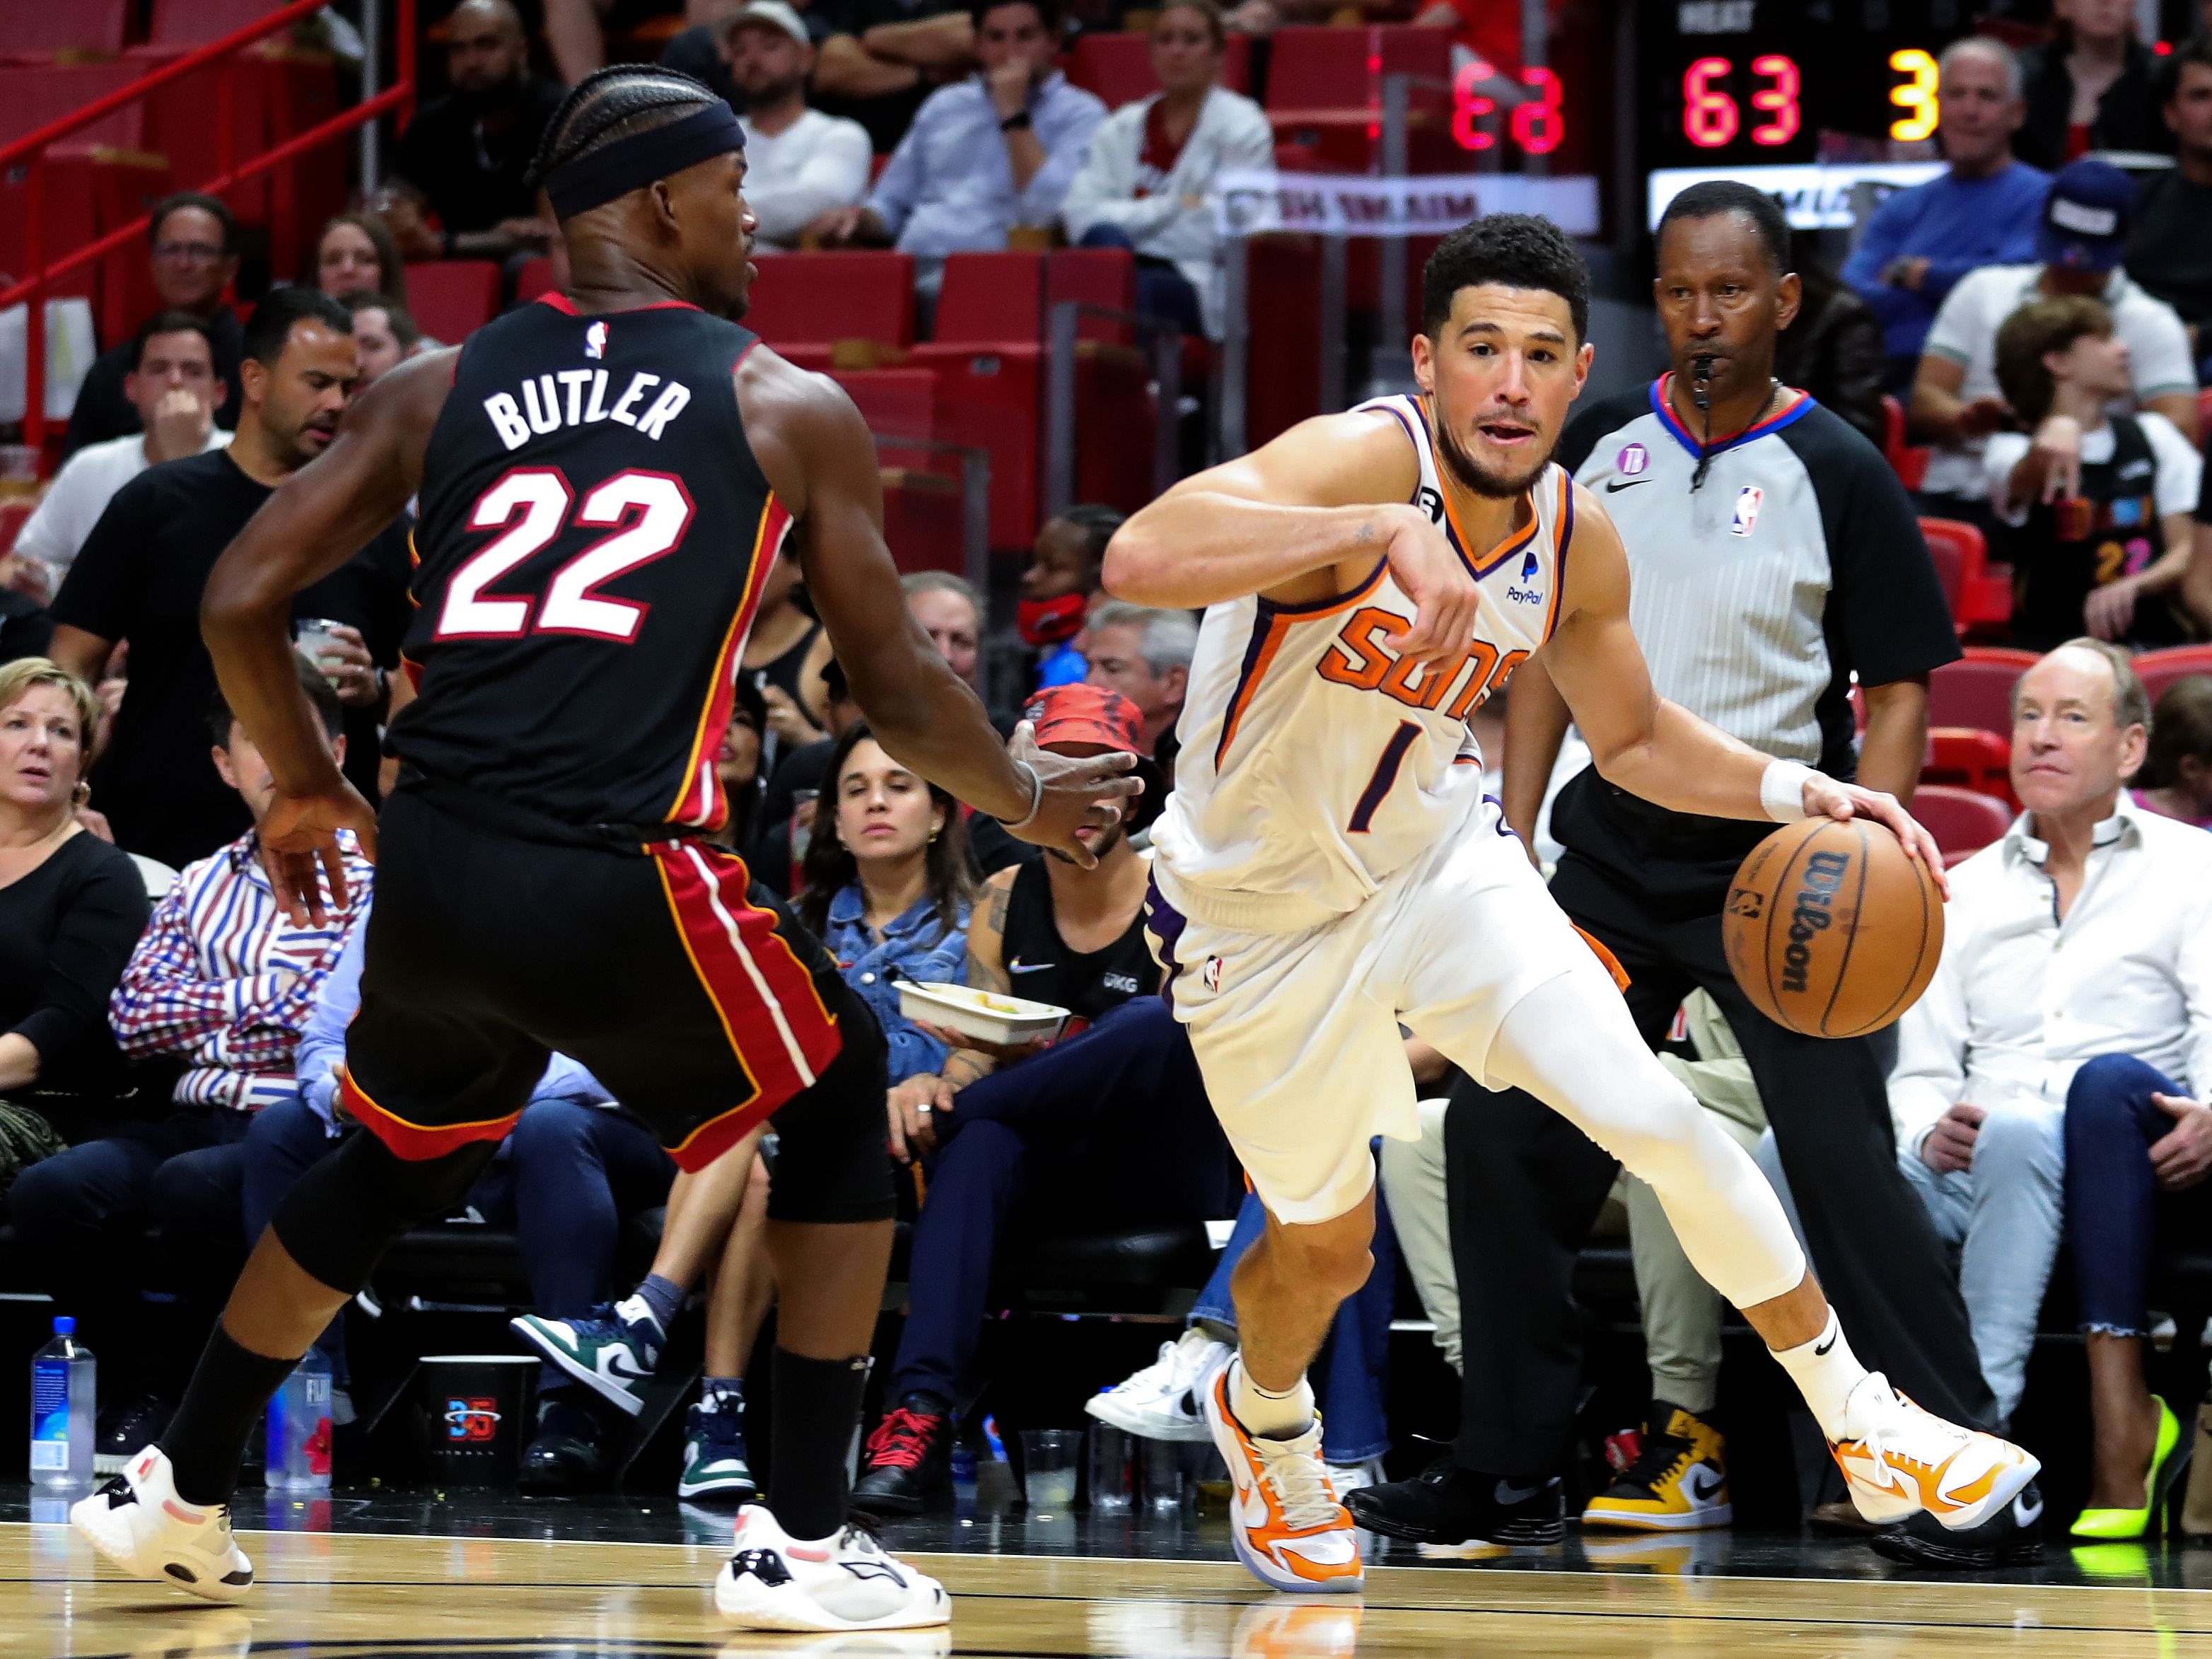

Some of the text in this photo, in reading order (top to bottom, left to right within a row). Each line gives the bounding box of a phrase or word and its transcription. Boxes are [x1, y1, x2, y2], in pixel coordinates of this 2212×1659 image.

[1684, 56, 1800, 146] 63
[1890, 49, 1940, 141] 3
[484, 369, 692, 450] BUTLER
[431, 465, 697, 644] 22
[1506, 586, 1543, 605] PayPal
[1346, 718, 1424, 834] 1
[1782, 851, 1851, 992] Wilson
[447, 1397, 496, 1441] 35
